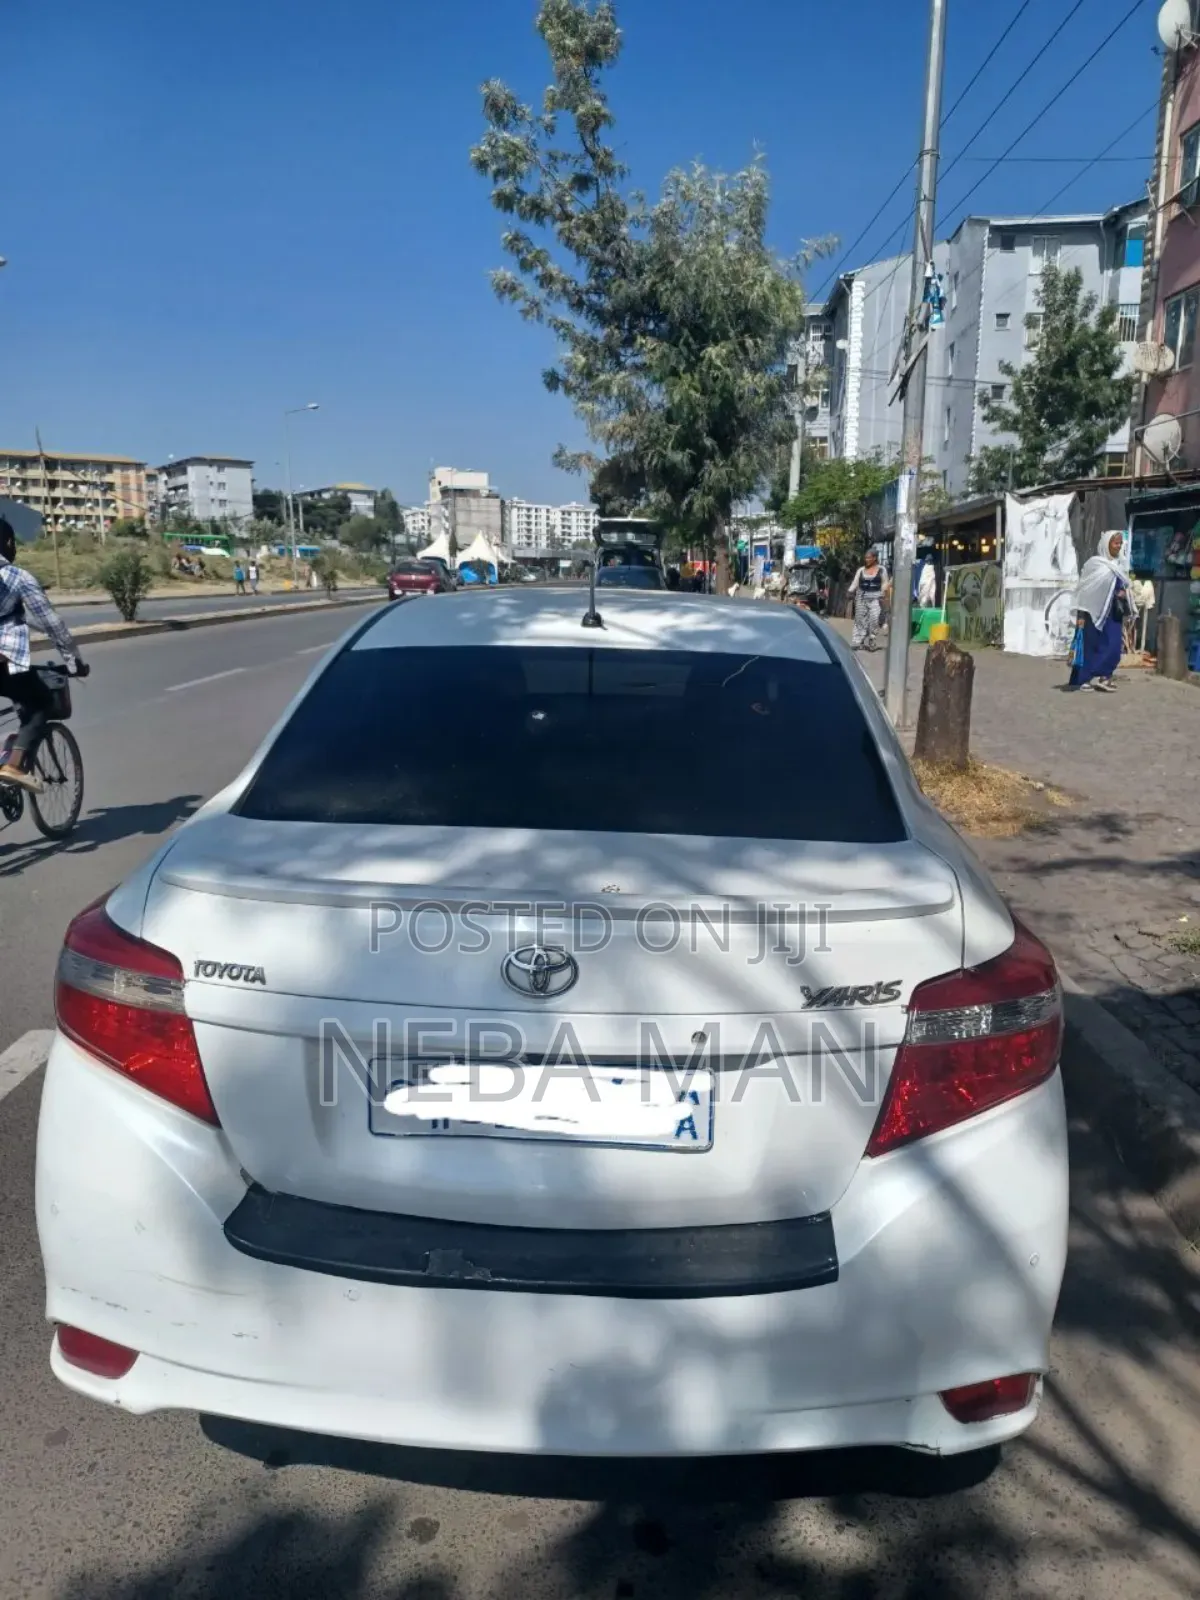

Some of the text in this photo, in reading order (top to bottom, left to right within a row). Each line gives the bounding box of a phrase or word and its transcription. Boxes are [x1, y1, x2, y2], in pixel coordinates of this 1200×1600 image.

[194, 959, 266, 985] TOYOTA
[800, 979, 903, 1009] YARIS
[674, 1113, 698, 1140] A
